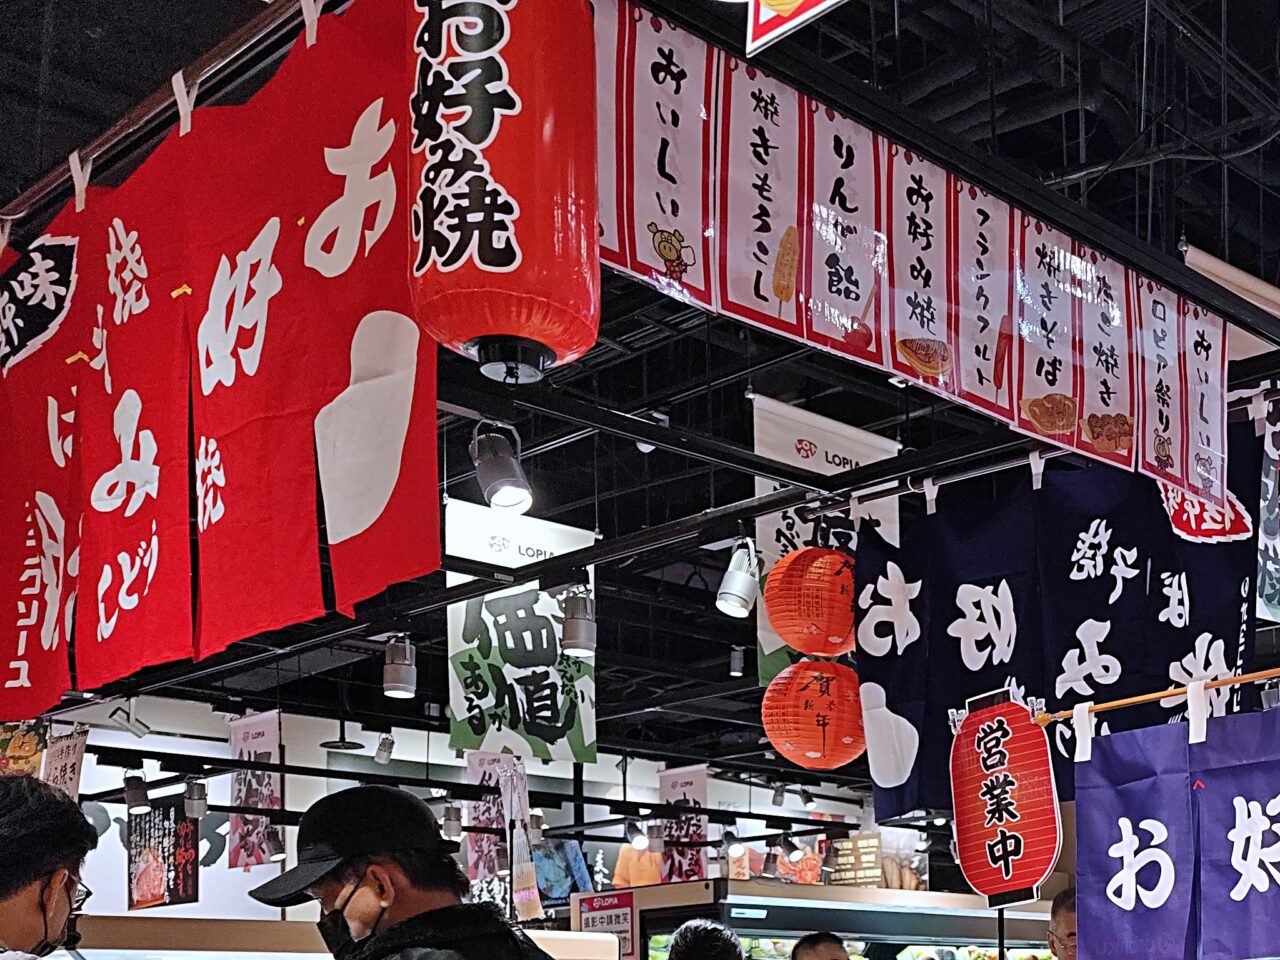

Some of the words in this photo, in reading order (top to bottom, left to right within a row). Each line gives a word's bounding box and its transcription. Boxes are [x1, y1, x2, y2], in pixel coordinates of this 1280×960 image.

[650, 46, 688, 218] おいしい
[750, 87, 782, 303] 焼きもろこし
[905, 175, 938, 337] お好み焼
[974, 207, 993, 387] フランクフルト
[1035, 241, 1063, 387] 焼きそば
[1150, 299, 1173, 432] ロピア祭り
[1192, 329, 1214, 447] おいしい
[974, 718, 1023, 881] 営業中
